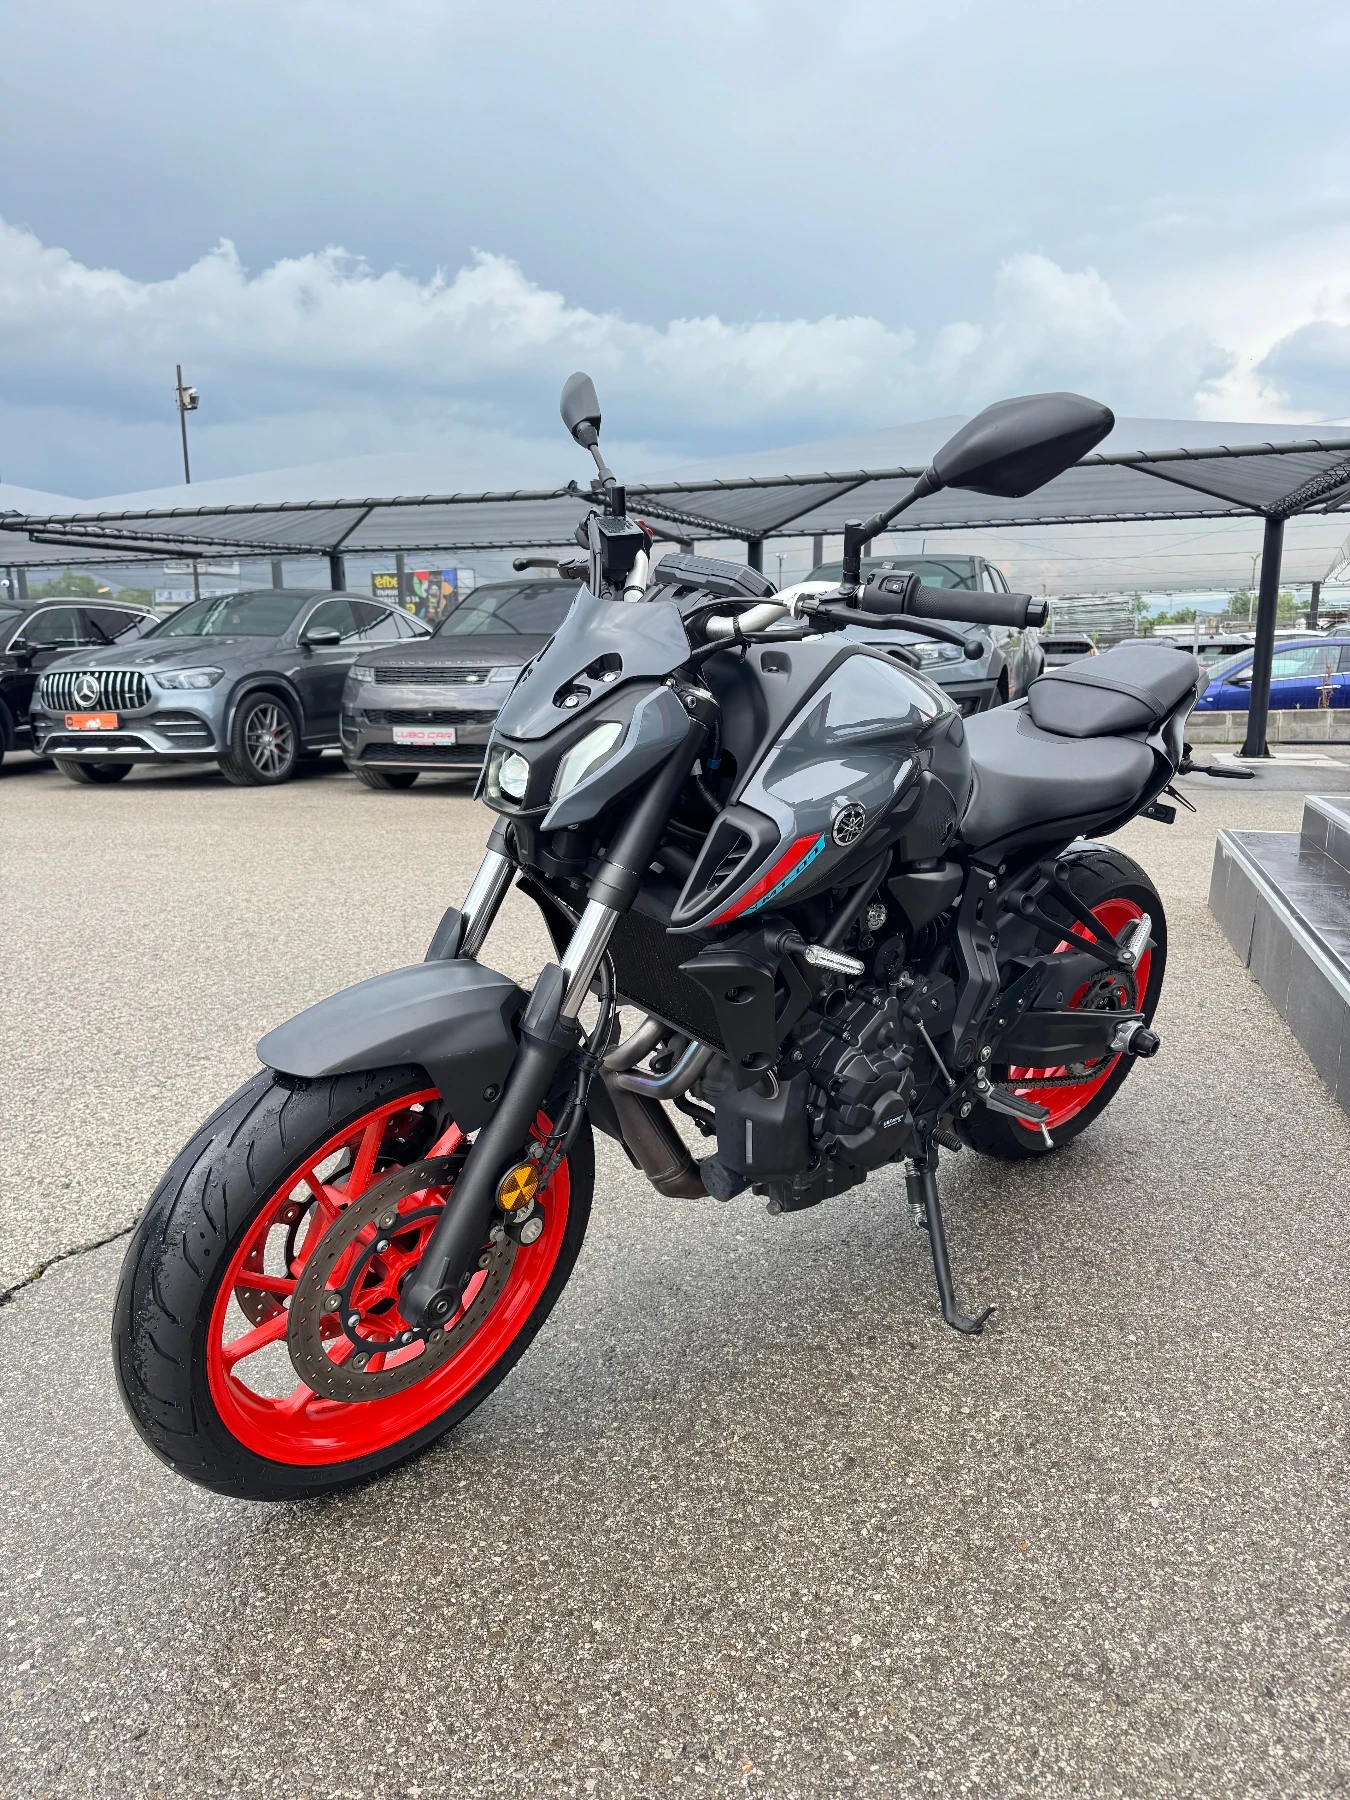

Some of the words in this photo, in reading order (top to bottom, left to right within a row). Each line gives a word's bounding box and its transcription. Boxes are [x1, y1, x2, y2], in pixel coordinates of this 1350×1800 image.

[395, 731, 425, 739] LUBO
[427, 731, 453, 739] CAR
[761, 846, 819, 904] MT-07
